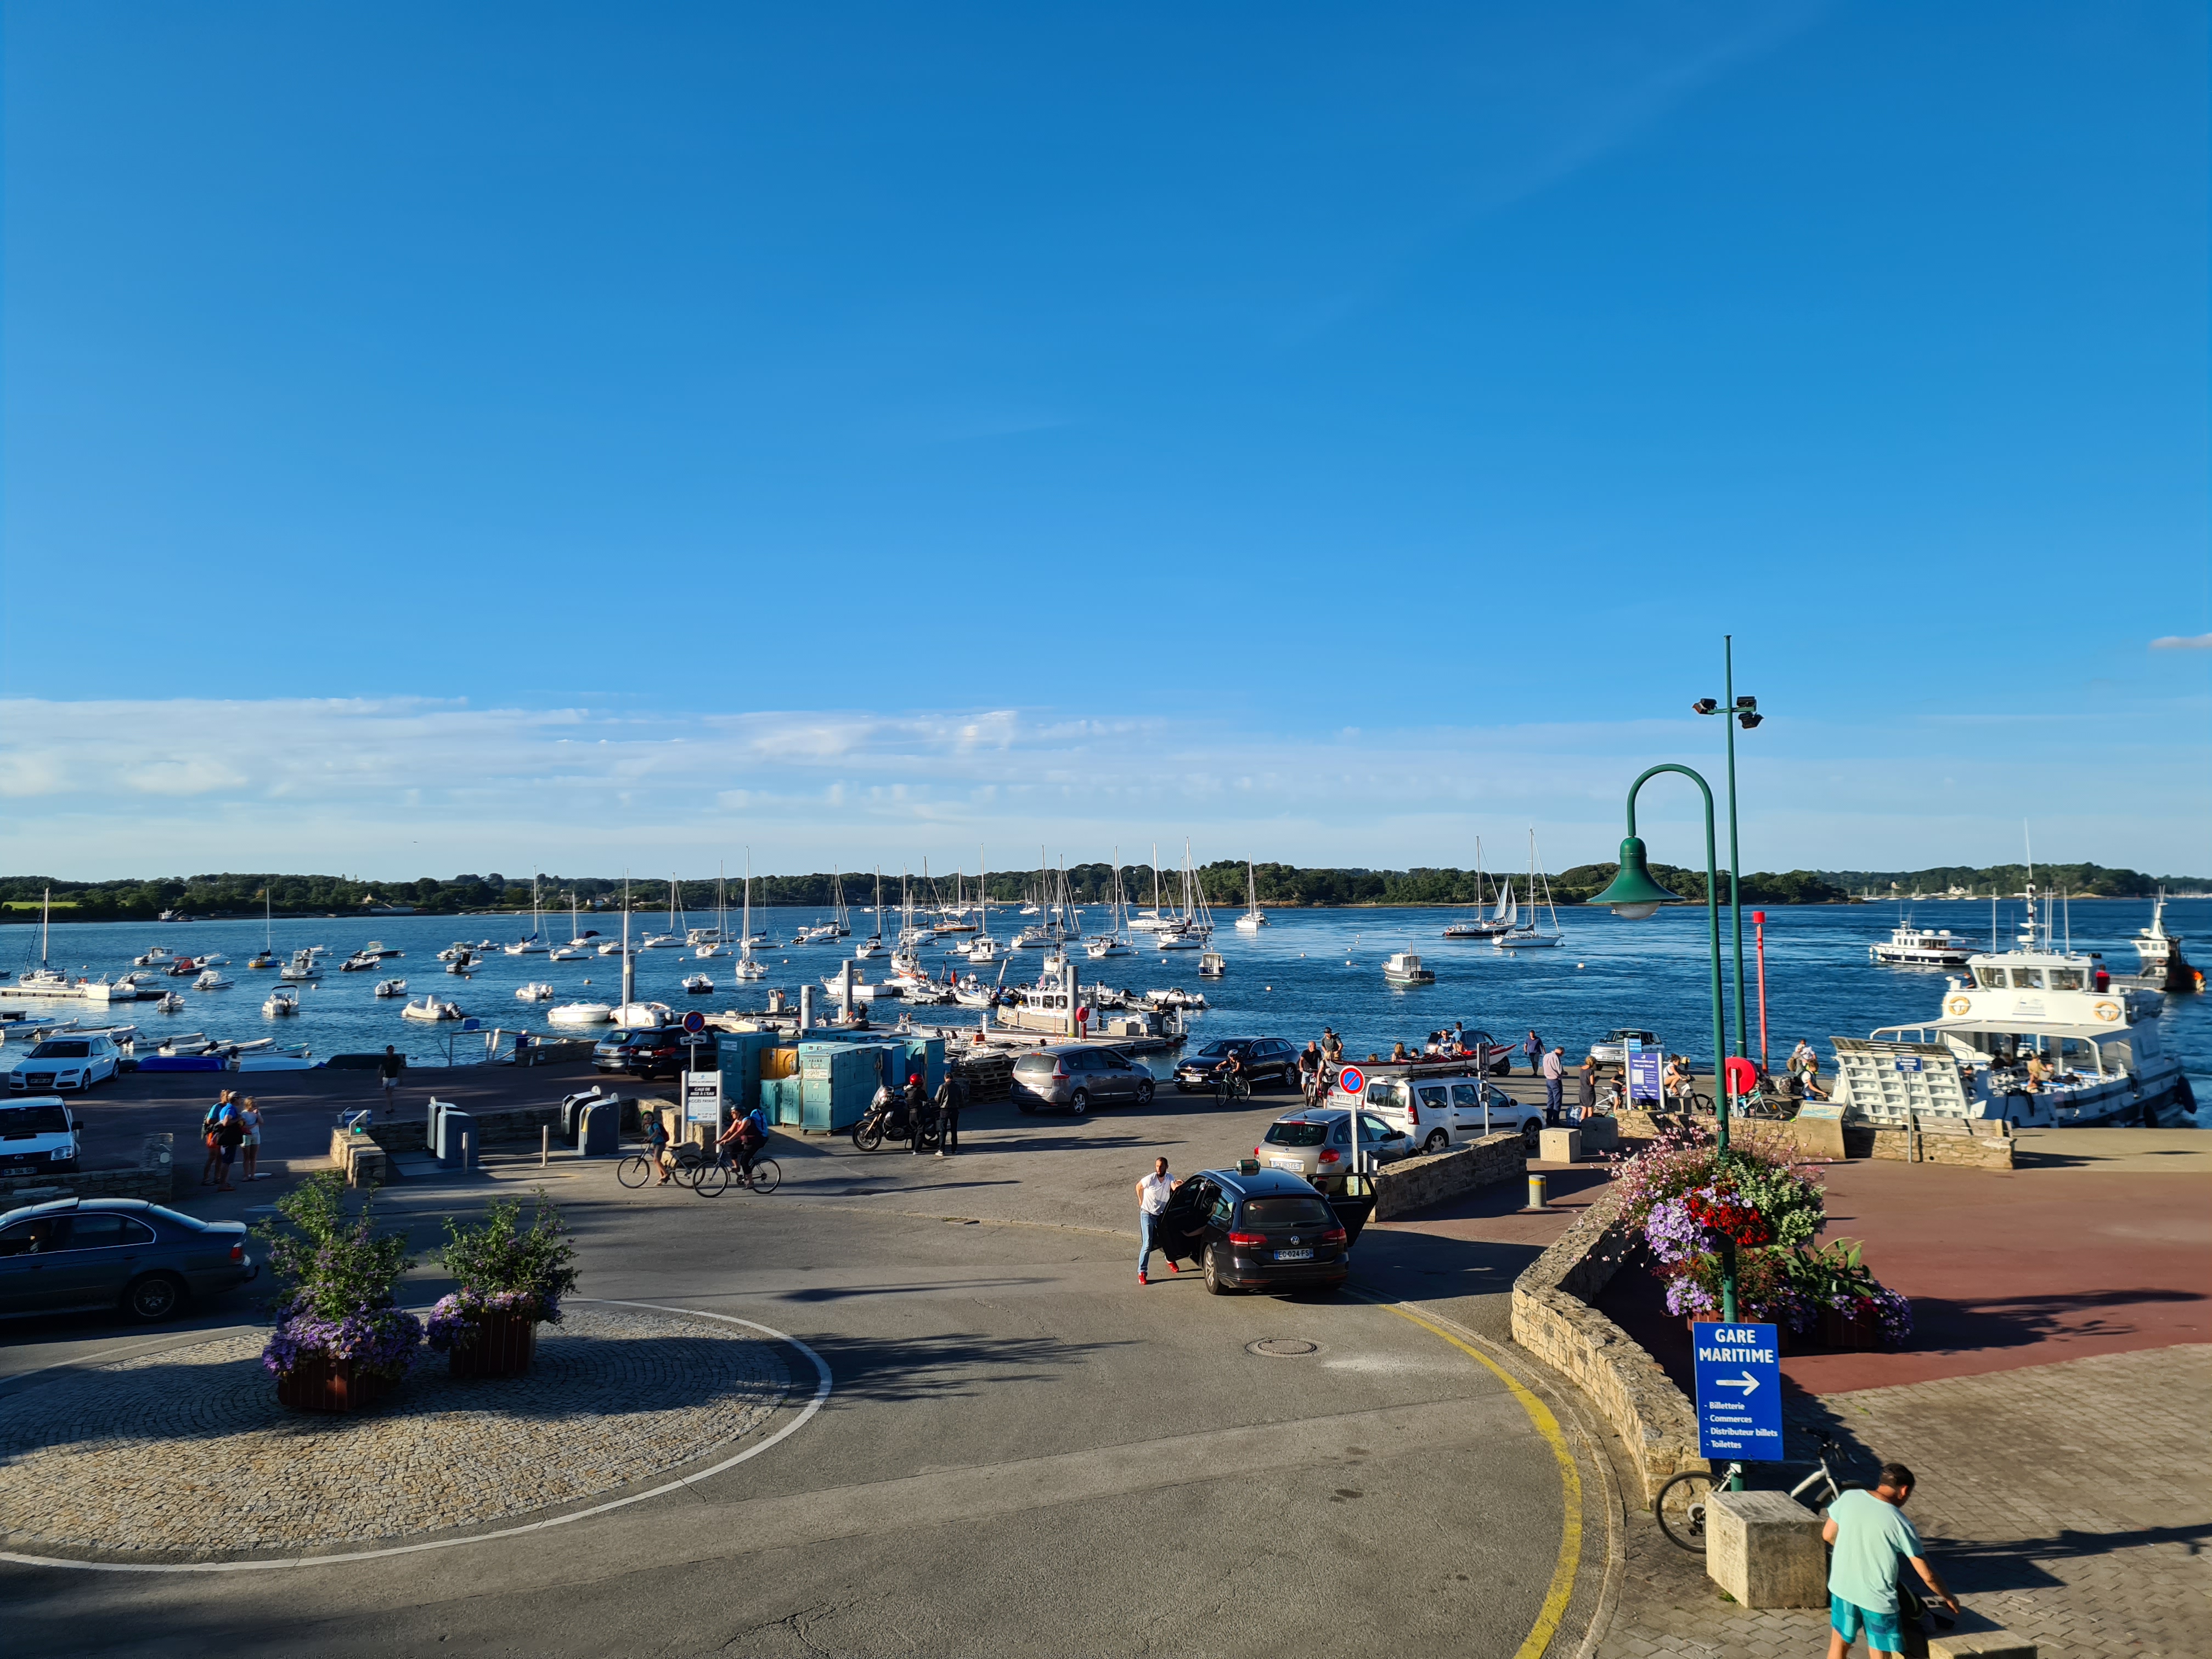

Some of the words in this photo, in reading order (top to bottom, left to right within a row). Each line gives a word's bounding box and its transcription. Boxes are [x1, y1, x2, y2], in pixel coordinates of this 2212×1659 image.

[1715, 1328, 1756, 1344] GARE
[1699, 1347, 1774, 1363] MARITIME
[1709, 1401, 1746, 1410] Billetterie
[1709, 1414, 1753, 1423] Commerces
[1710, 1427, 1755, 1436] Distributeur
[1755, 1428, 1779, 1437] billets
[1711, 1440, 1742, 1449] Toilettes
